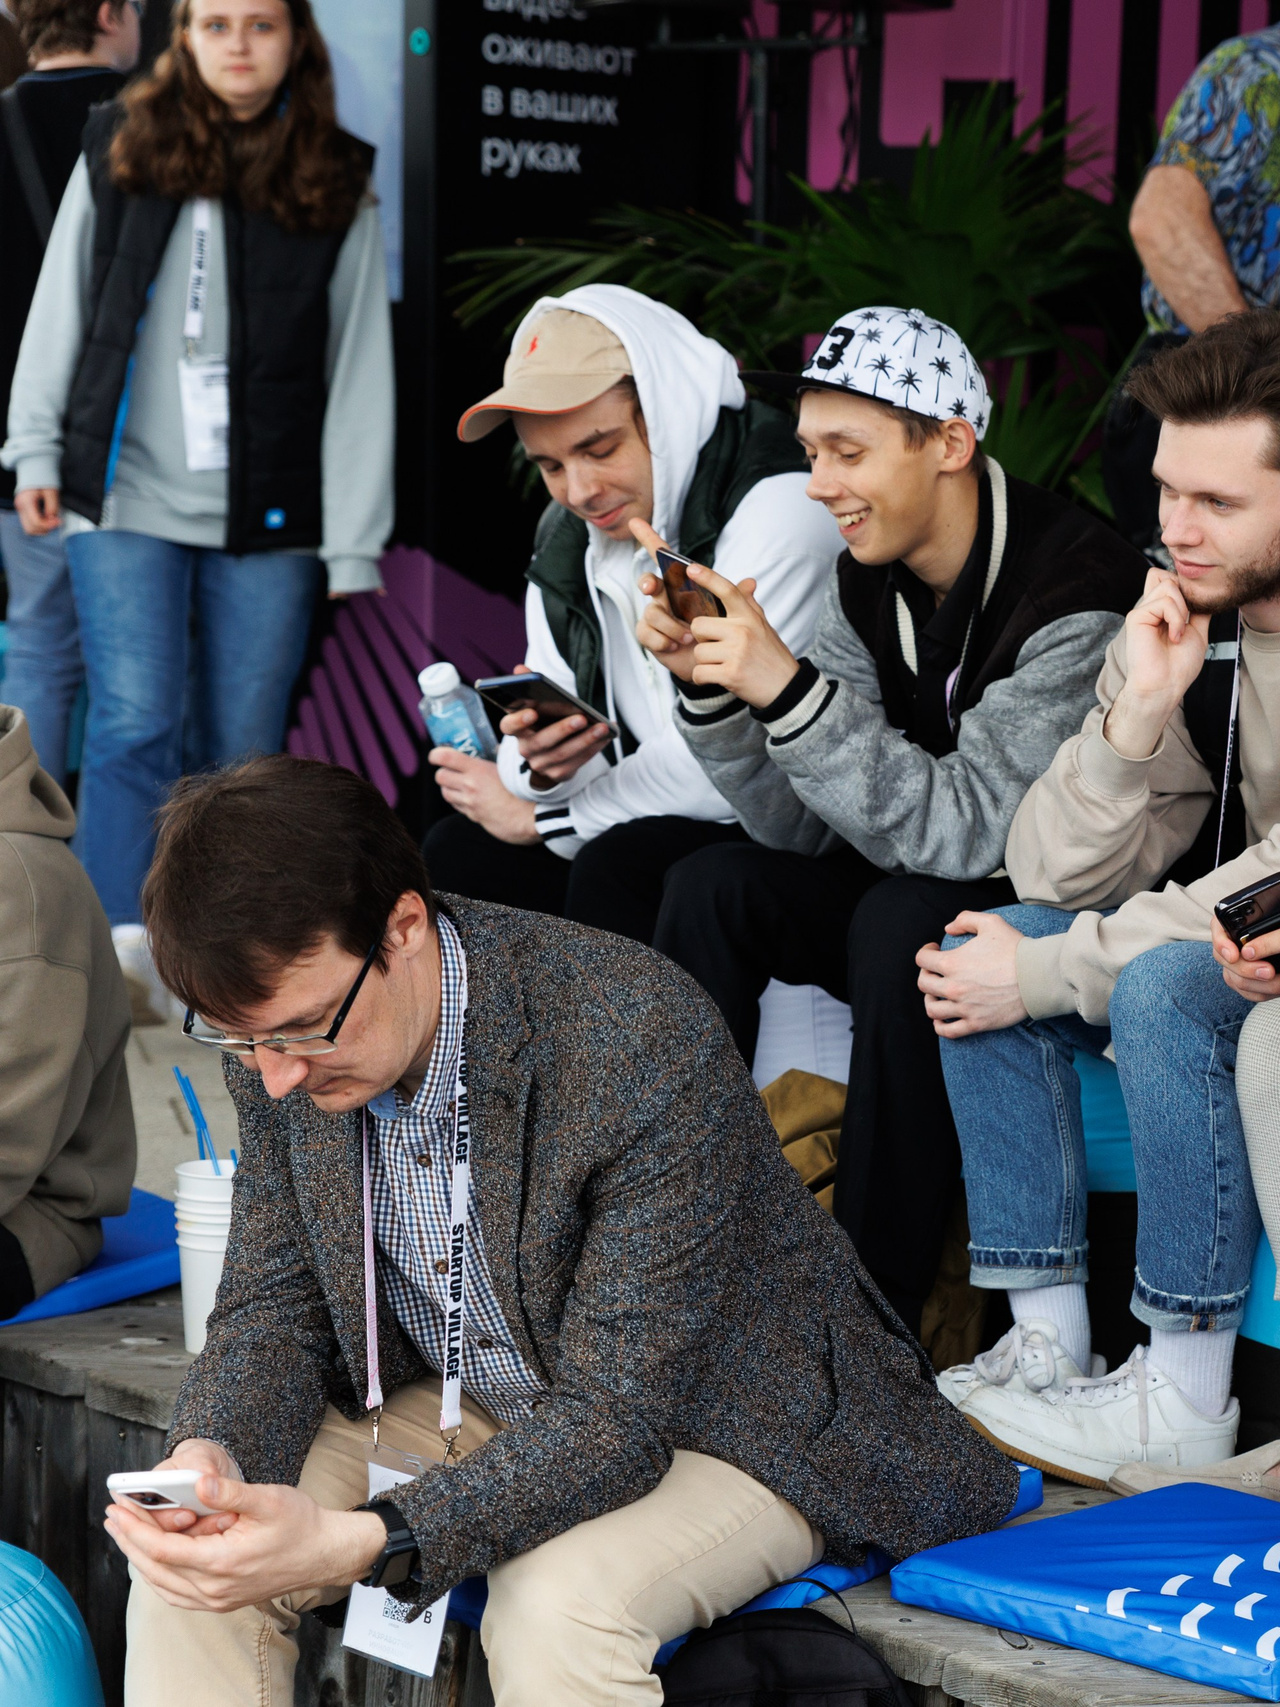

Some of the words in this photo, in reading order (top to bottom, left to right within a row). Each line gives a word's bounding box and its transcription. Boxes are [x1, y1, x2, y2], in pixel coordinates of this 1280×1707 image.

[481, 32, 637, 76] оживают
[481, 84, 504, 116] в
[510, 86, 620, 127] ваших
[481, 136, 582, 179] руках
[449, 1223, 464, 1303] STARTUP
[446, 1306, 461, 1381] VILLAGE
